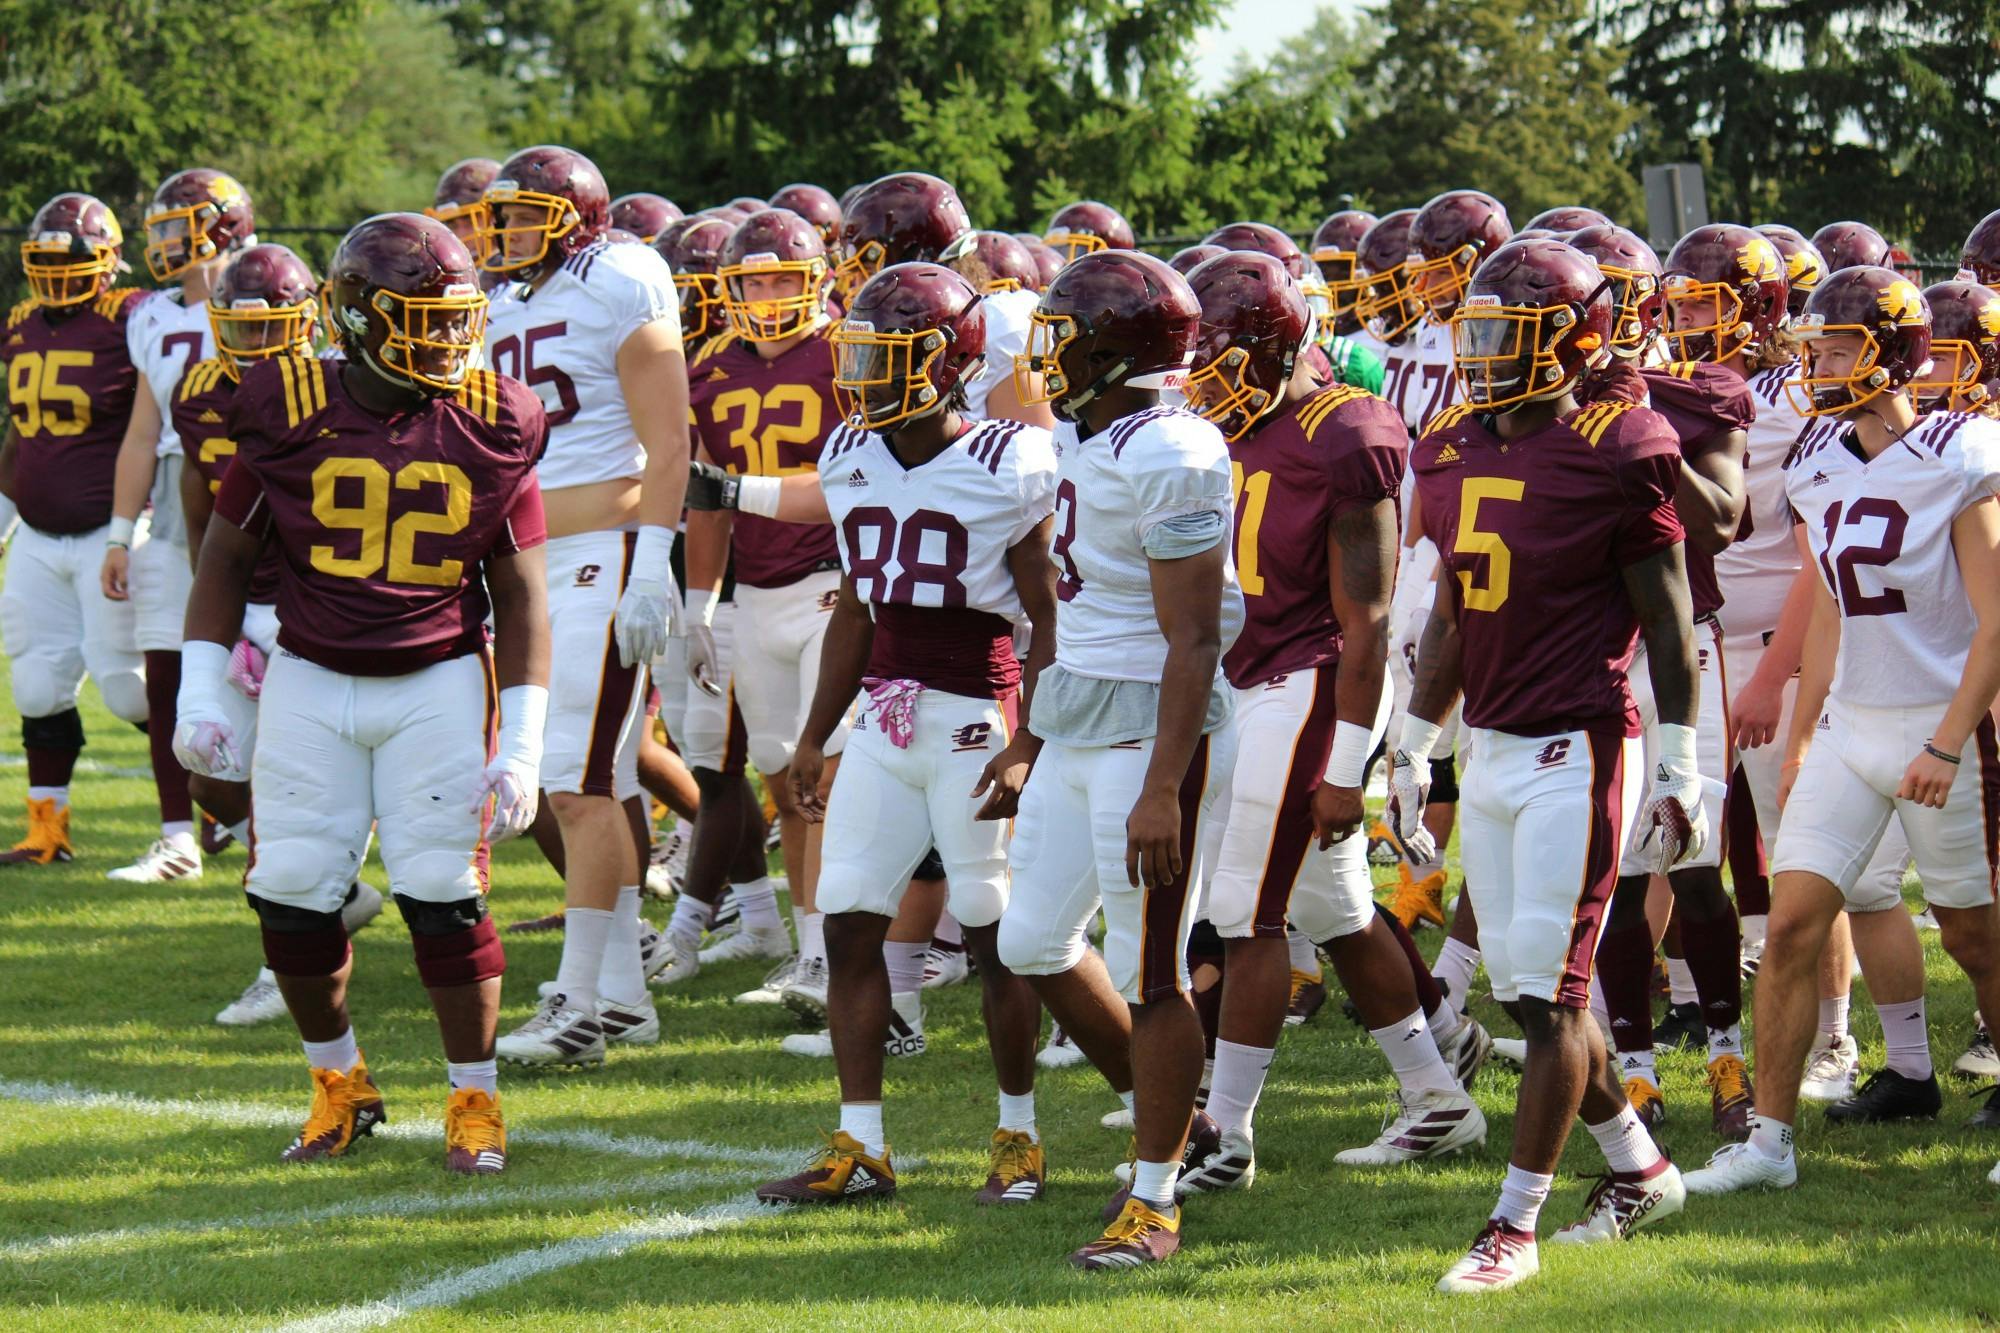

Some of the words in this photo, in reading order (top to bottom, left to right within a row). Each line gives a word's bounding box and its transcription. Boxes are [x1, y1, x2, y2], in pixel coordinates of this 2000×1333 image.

[8, 350, 94, 438] 95
[711, 384, 822, 476] 32
[310, 457, 472, 586] 92
[843, 506, 968, 608] 88
[1232, 461, 1272, 596] 1
[1455, 477, 1525, 612] 5
[1820, 497, 1909, 617] 12
[844, 1178, 878, 1195] adidas
